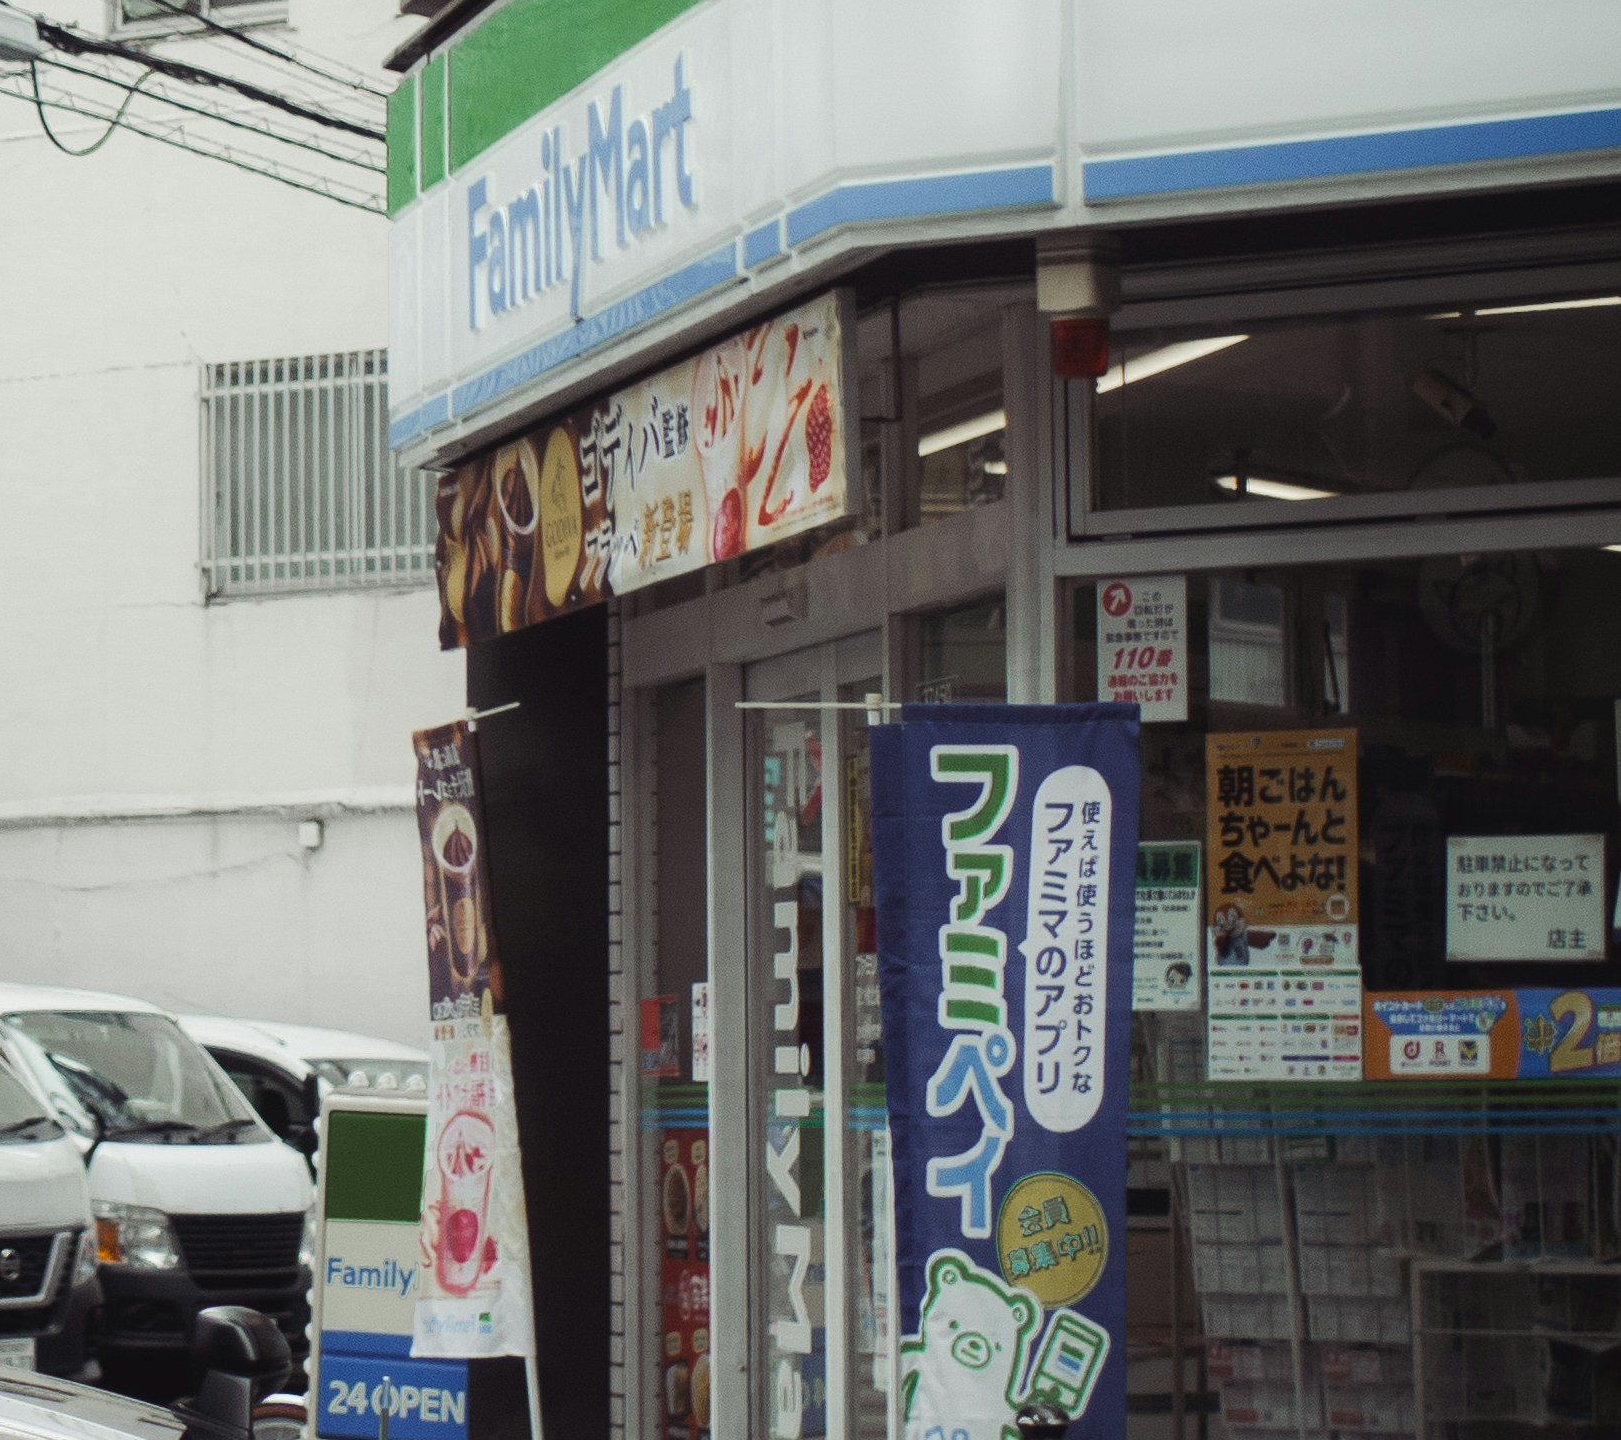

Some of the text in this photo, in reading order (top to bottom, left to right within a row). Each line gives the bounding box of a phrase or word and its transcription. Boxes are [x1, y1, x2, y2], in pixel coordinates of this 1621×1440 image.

[466, 50, 695, 331] FamilyMart
[1114, 646, 1174, 670] 110番
[1216, 764, 1347, 807] 朝ごはん
[1218, 809, 1347, 847] ちゃーんと
[1217, 852, 1347, 894] 食べよな!
[1456, 854, 1590, 873] 駐車禁止になって
[1457, 880, 1592, 898] おりますのでご了承
[1034, 801, 1076, 1096] ファミマのアプリ
[1071, 800, 1102, 1094] 使えば使うほどおトクな
[1547, 927, 1587, 949] 店主
[930, 747, 1015, 1235] ファミペイ
[1017, 1195, 1072, 1239] 会員
[325, 1257, 417, 1297] Family
